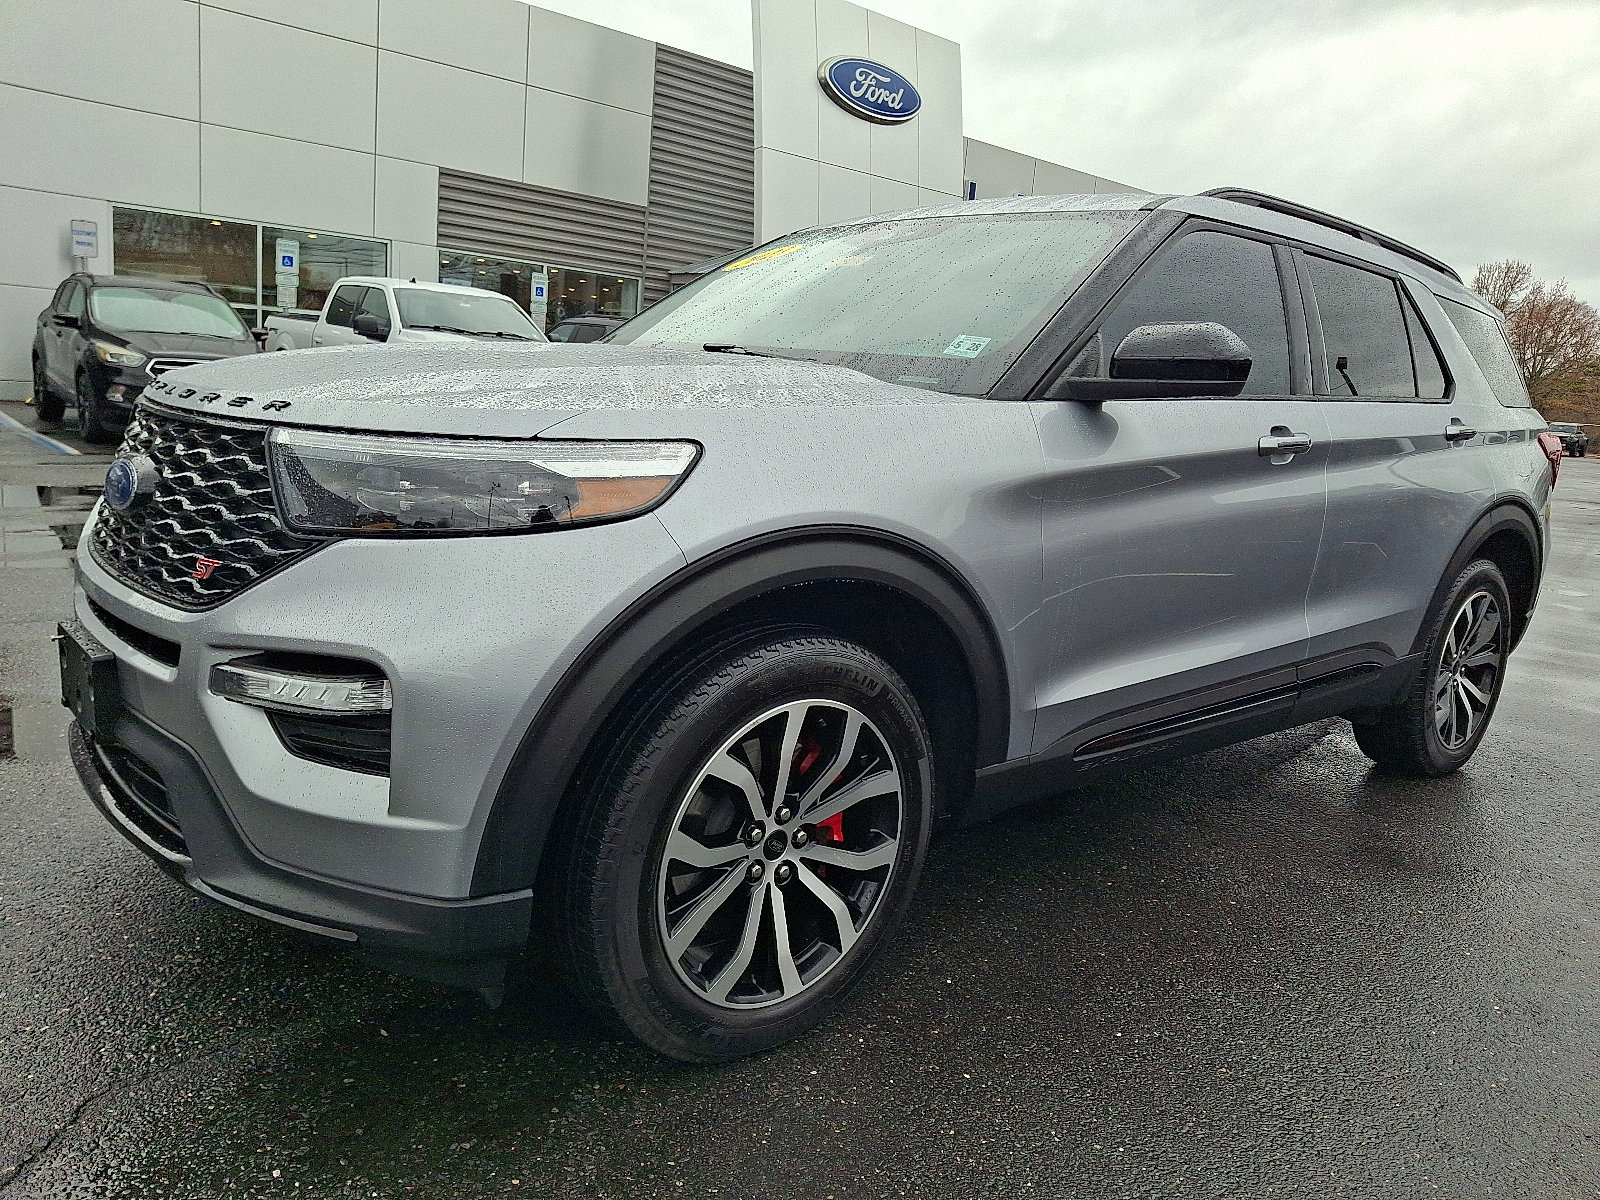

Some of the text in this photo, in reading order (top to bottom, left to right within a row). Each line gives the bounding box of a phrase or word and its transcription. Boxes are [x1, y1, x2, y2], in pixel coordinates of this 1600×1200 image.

[849, 67, 904, 110] Ford
[192, 557, 224, 580] ST
[886, 692, 916, 733] PRIMACY
